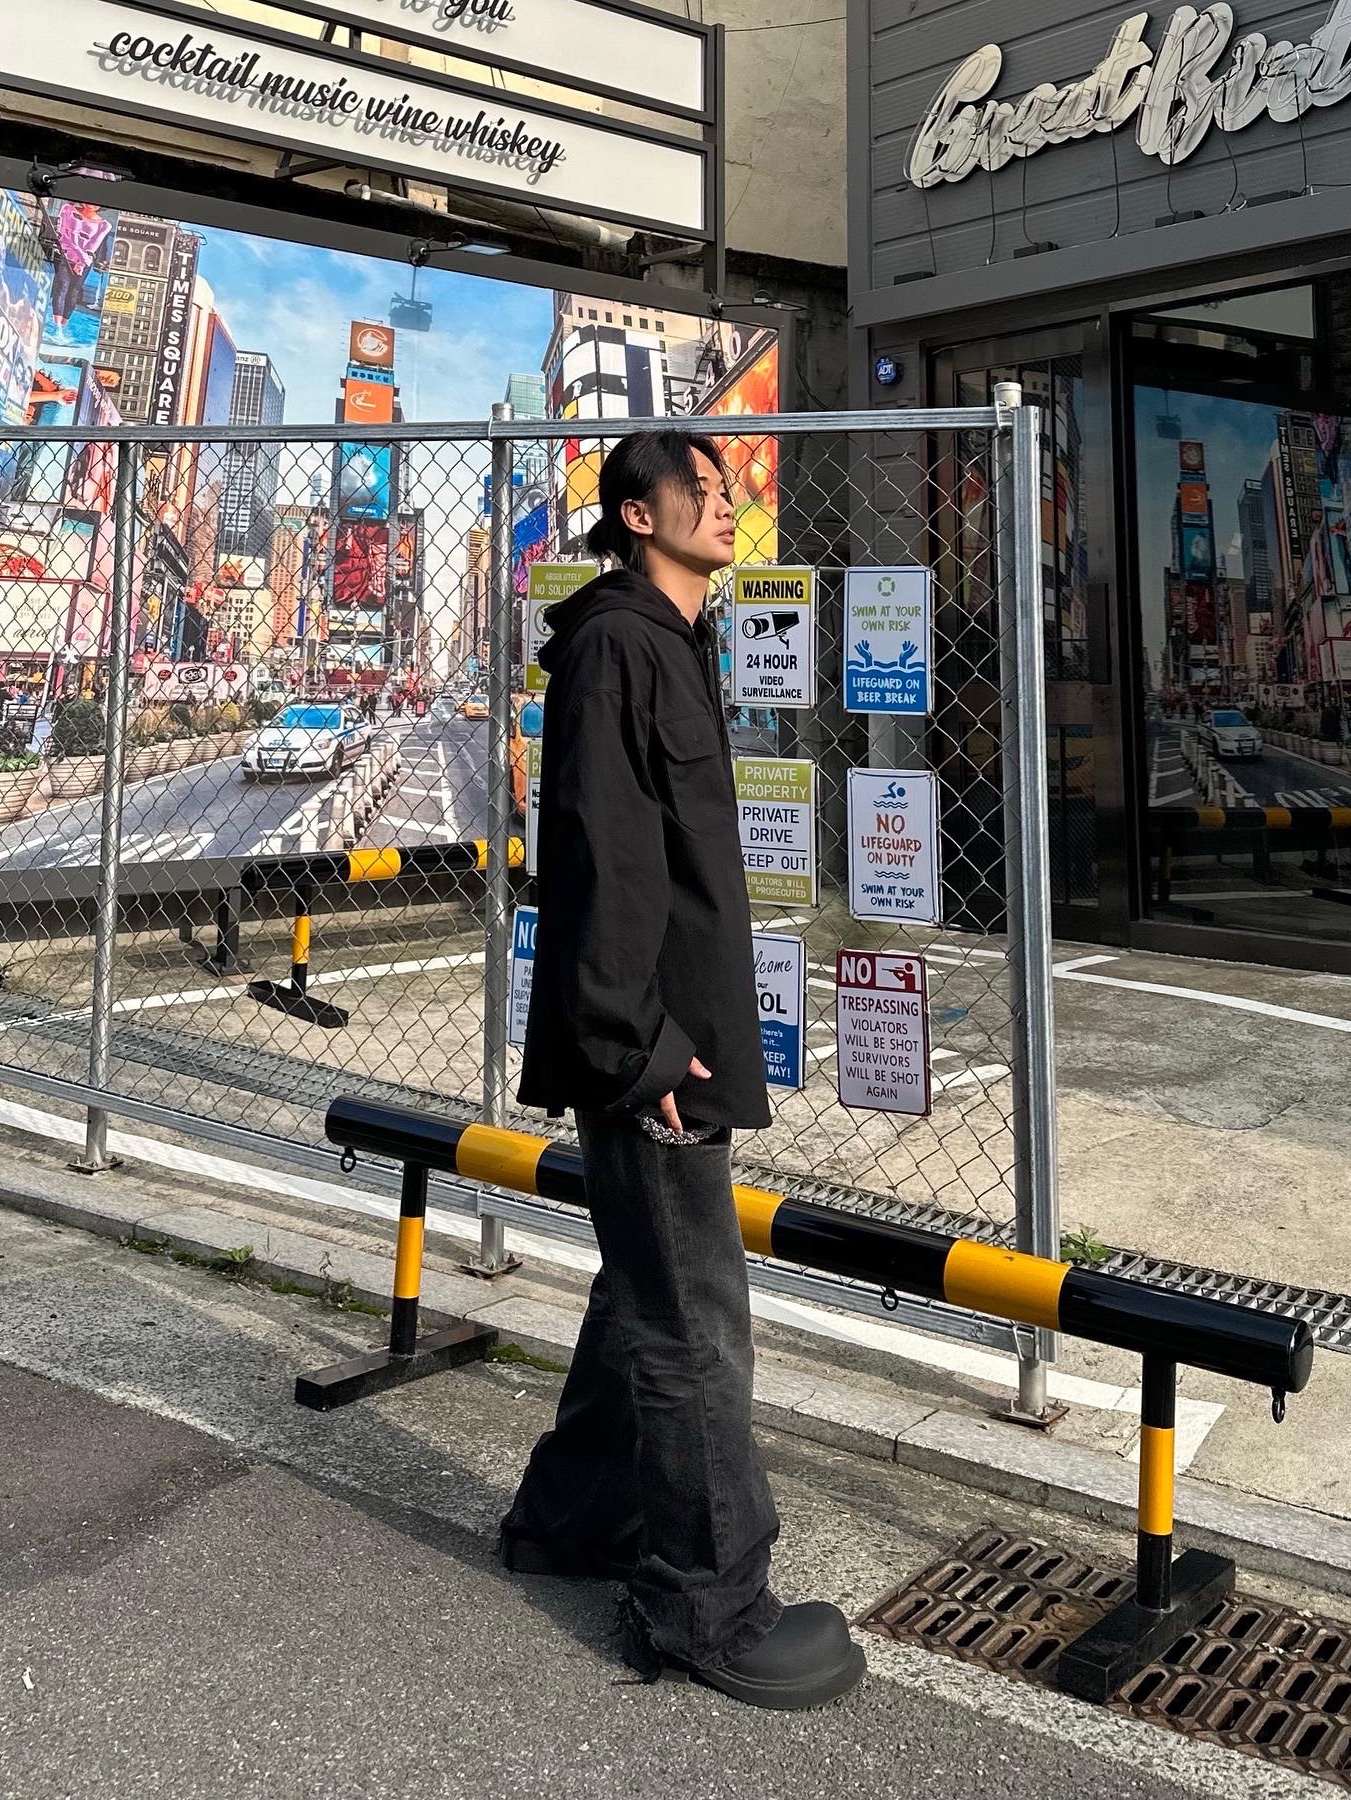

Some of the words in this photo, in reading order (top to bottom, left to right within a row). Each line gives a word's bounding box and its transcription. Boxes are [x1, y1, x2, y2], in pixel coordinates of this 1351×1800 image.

[94, 31, 260, 90] cocktail
[259, 71, 363, 114] music
[366, 93, 445, 134] wine
[445, 110, 566, 174] whiskey
[171, 251, 193, 322] TIMES
[155, 331, 181, 425] SQUARE
[545, 572, 582, 582] ABSOLUTELY
[534, 584, 545, 596] NO
[742, 580, 804, 599] WARNING
[852, 605, 877, 617] SWIM
[880, 606, 891, 617] AT
[895, 605, 922, 618] YOUR
[862, 621, 885, 631] OWN
[888, 621, 911, 632] RISK
[746, 654, 760, 669] 24
[763, 654, 798, 670] HOUR
[759, 675, 784, 686] VIDEO
[852, 676, 903, 690] LIFEGUARD
[905, 679, 920, 690] ON
[742, 687, 802, 699] SURVEILLANCE
[856, 691, 881, 703] BEER
[884, 692, 917, 705] BREAK
[744, 766, 798, 782] PRIVATE
[738, 783, 808, 800] PROPERTY
[742, 806, 800, 824] PRIVATE
[876, 812, 906, 835] NO
[750, 827, 794, 844] DRIVE
[861, 835, 922, 853] LIFEGUARD
[780, 856, 808, 871] OUT
[867, 851, 883, 864] ON
[886, 854, 916, 868] DUTY
[746, 875, 783, 887] IOLATORS
[786, 879, 806, 889] WILL
[755, 886, 807, 899] PROSECUTED
[861, 883, 884, 894] SWIM
[887, 885, 897, 895] AT
[900, 886, 925, 898] YOUR
[870, 896, 892, 908] OWN
[895, 898, 915, 909] RISK
[841, 955, 872, 985] NO
[758, 991, 788, 1015] OL
[841, 995, 919, 1017] TRESPASSING
[851, 1017, 908, 1035] VIOLATORS
[844, 1033, 869, 1048] WILL
[873, 1036, 885, 1050] BE
[890, 1038, 919, 1053] SHOT
[763, 1050, 786, 1064] KEEP
[851, 1050, 910, 1068] SURVIVORS
[767, 1064, 791, 1079] WAY!
[845, 1066, 870, 1081] WILL
[874, 1069, 886, 1082] BE
[890, 1071, 920, 1086] SHOT
[866, 1085, 898, 1100] AGAIN
